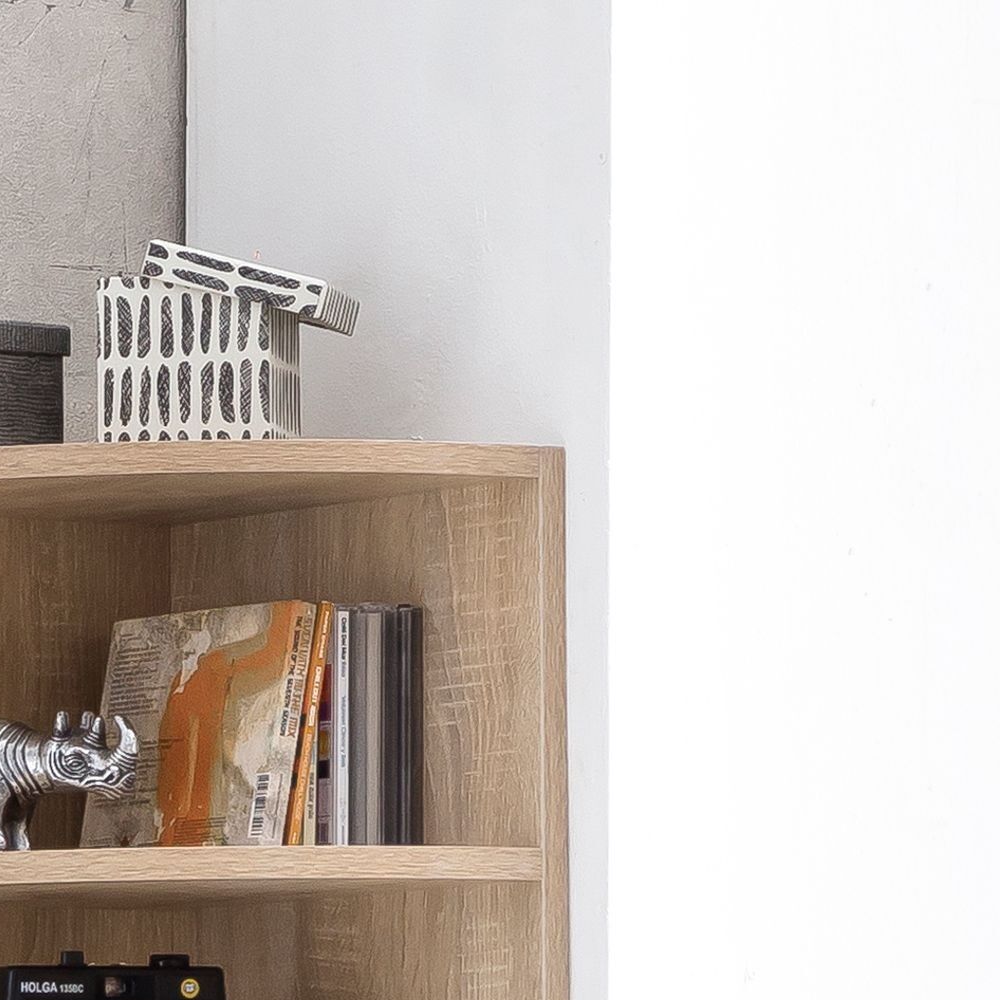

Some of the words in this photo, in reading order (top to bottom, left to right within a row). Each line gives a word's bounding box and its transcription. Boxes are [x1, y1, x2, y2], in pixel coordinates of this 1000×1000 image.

[286, 716, 298, 737] MIX
[21, 982, 57, 993] HOLGA
[60, 985, 84, 993] 135BC
